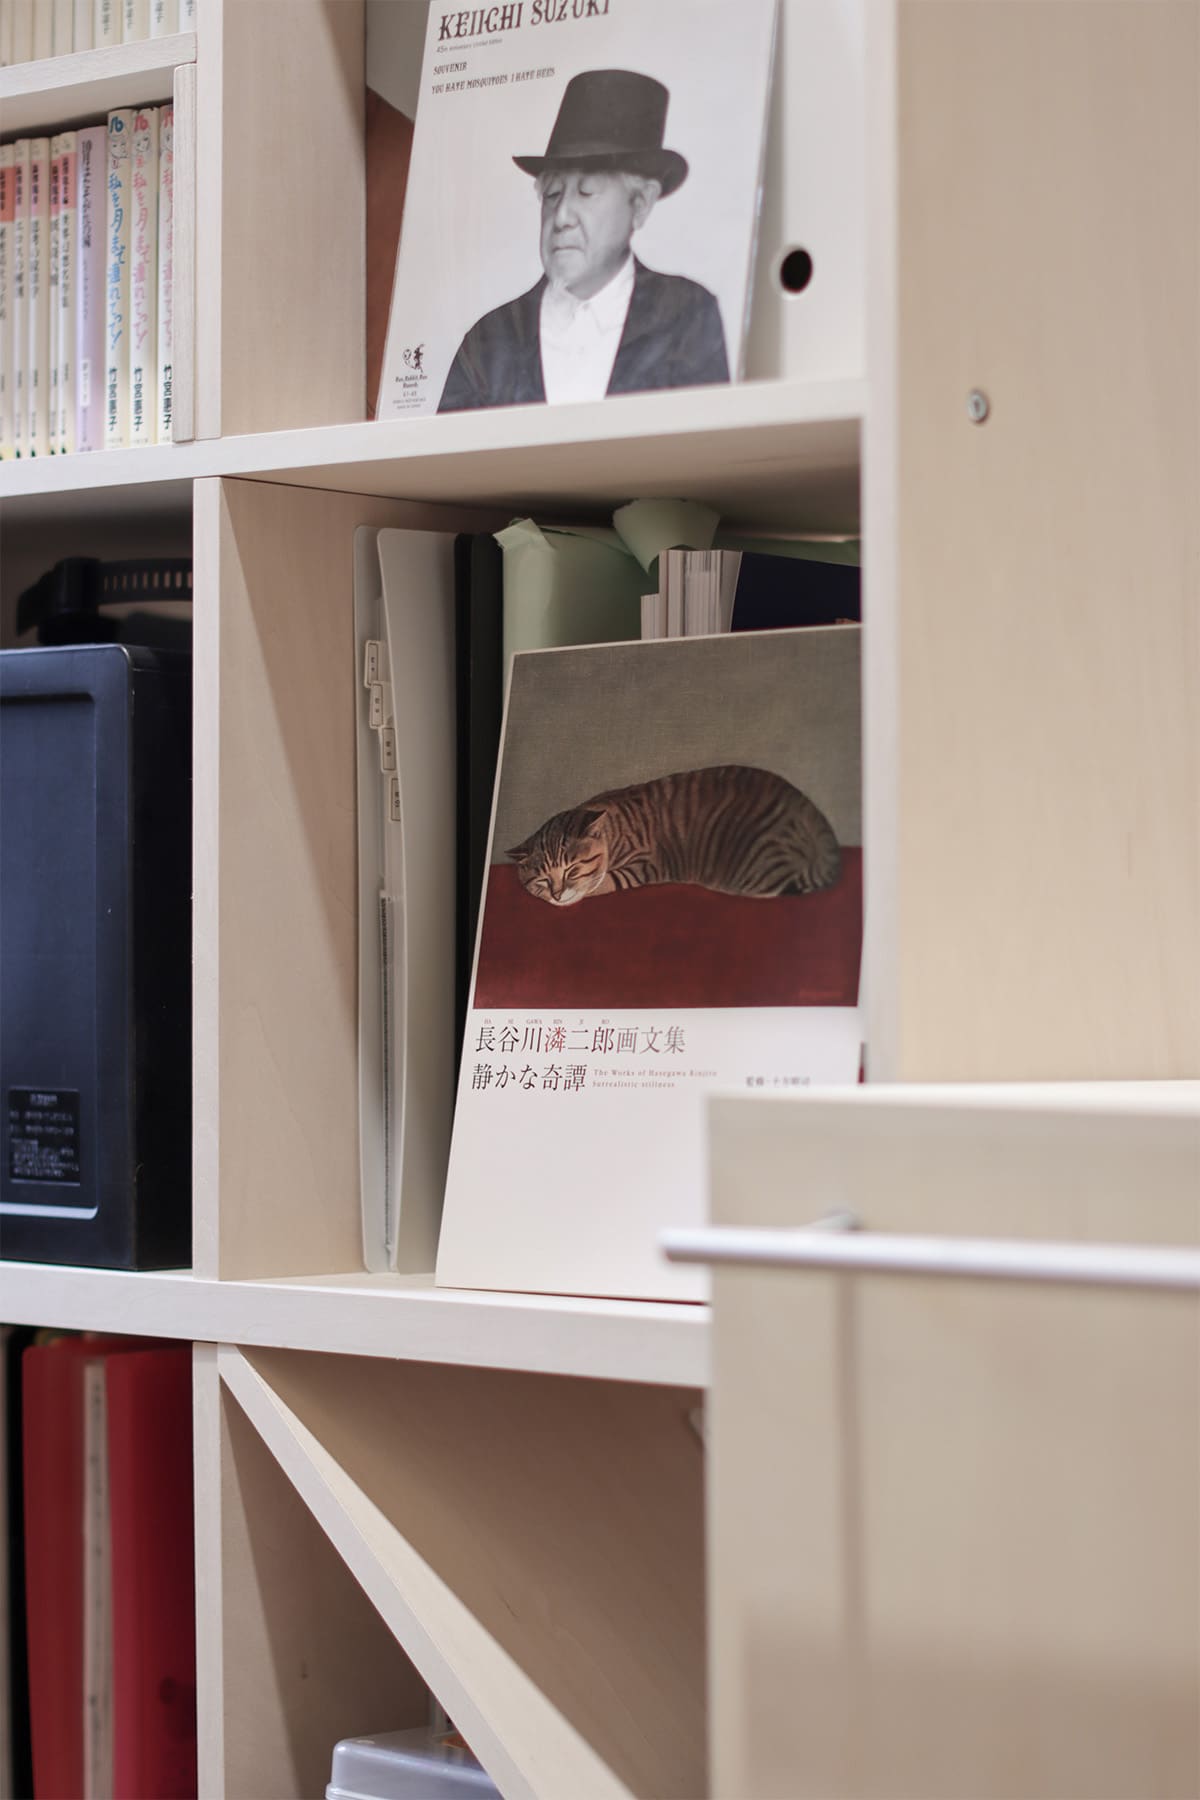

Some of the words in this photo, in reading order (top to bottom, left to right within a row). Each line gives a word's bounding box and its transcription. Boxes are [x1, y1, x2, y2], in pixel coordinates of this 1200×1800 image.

[438, 3, 524, 41] KEIICHI
[433, 62, 467, 75] SOUVENIR
[432, 84, 445, 95] YOU
[445, 80, 465, 93] HATE
[466, 74, 508, 89] MOSQUITOES
[515, 70, 535, 82] HATE
[471, 1063, 588, 1092] 静かな奇譚
